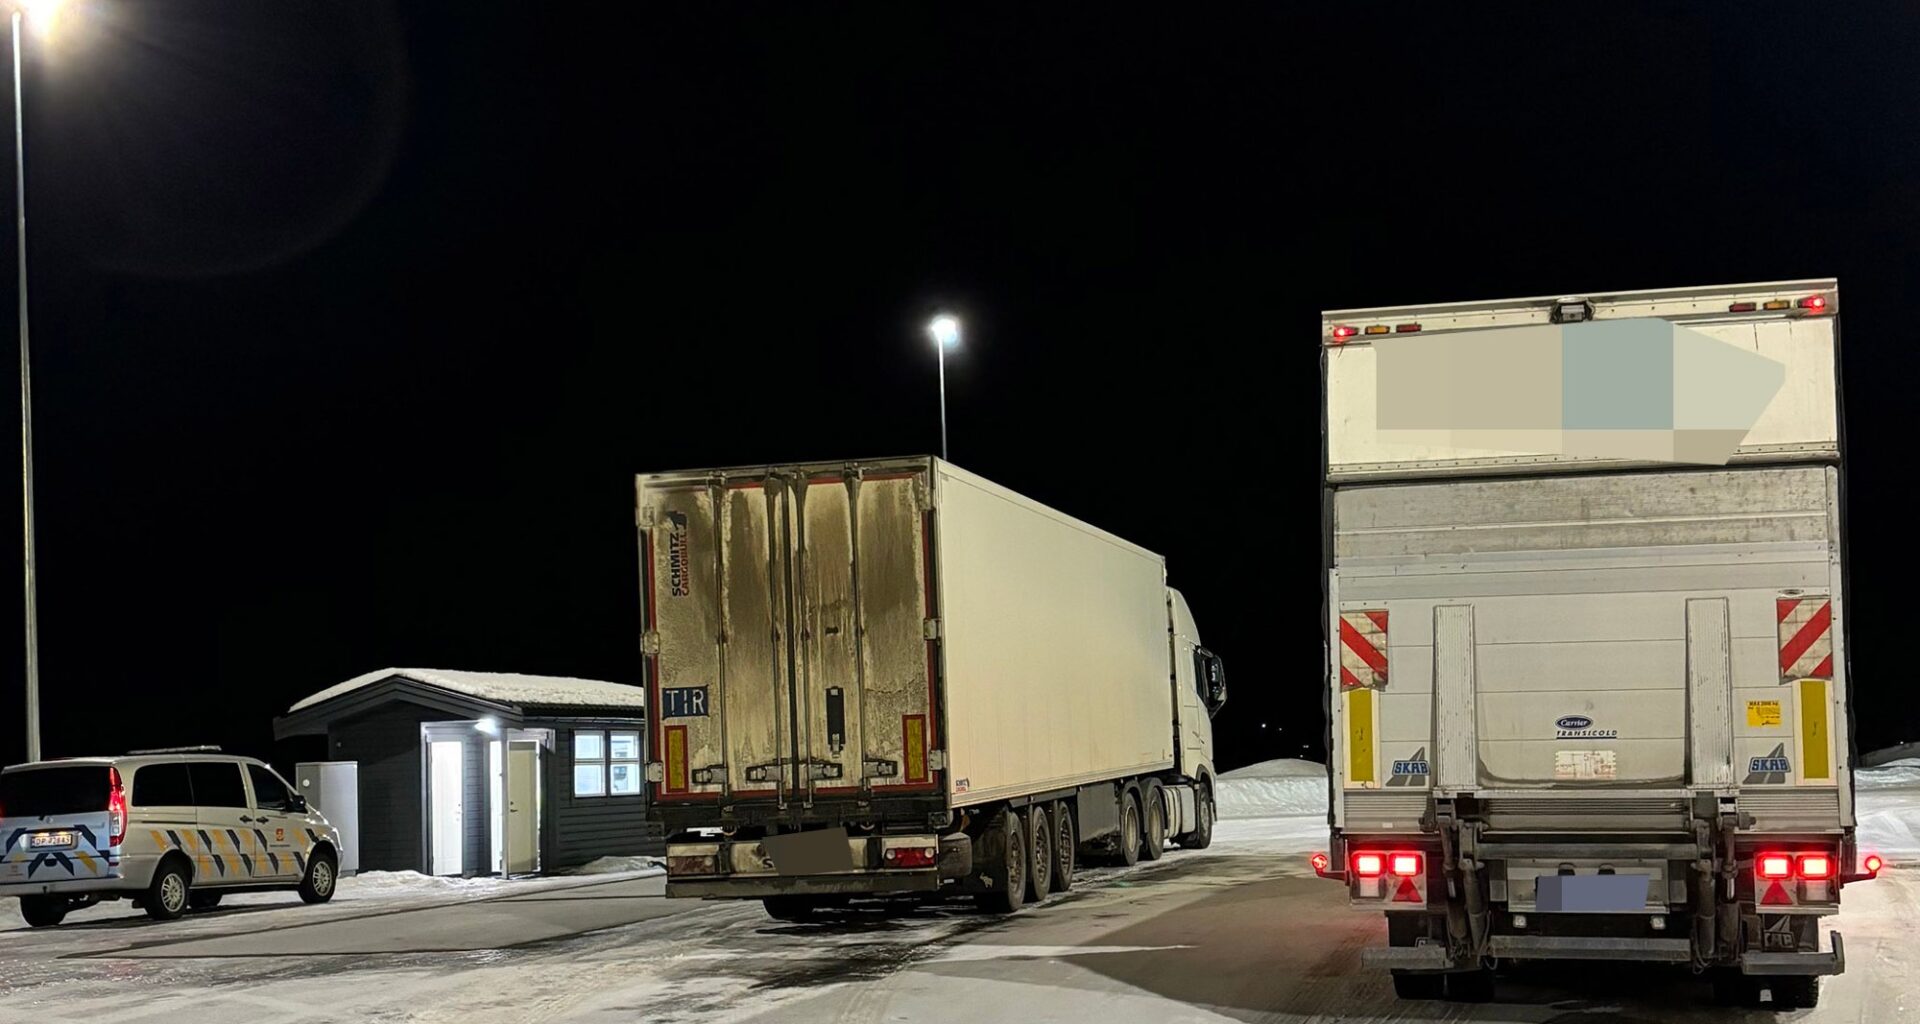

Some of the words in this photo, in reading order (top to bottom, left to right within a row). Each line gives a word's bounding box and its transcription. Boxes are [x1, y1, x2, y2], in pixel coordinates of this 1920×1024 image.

[670, 532, 681, 596] SCHMITZ
[680, 531, 690, 597] CARGOBULL
[665, 689, 705, 715] TIR
[1560, 719, 1588, 727] Carrier
[1394, 762, 1428, 774] SKAB
[1751, 759, 1788, 771] SKAB
